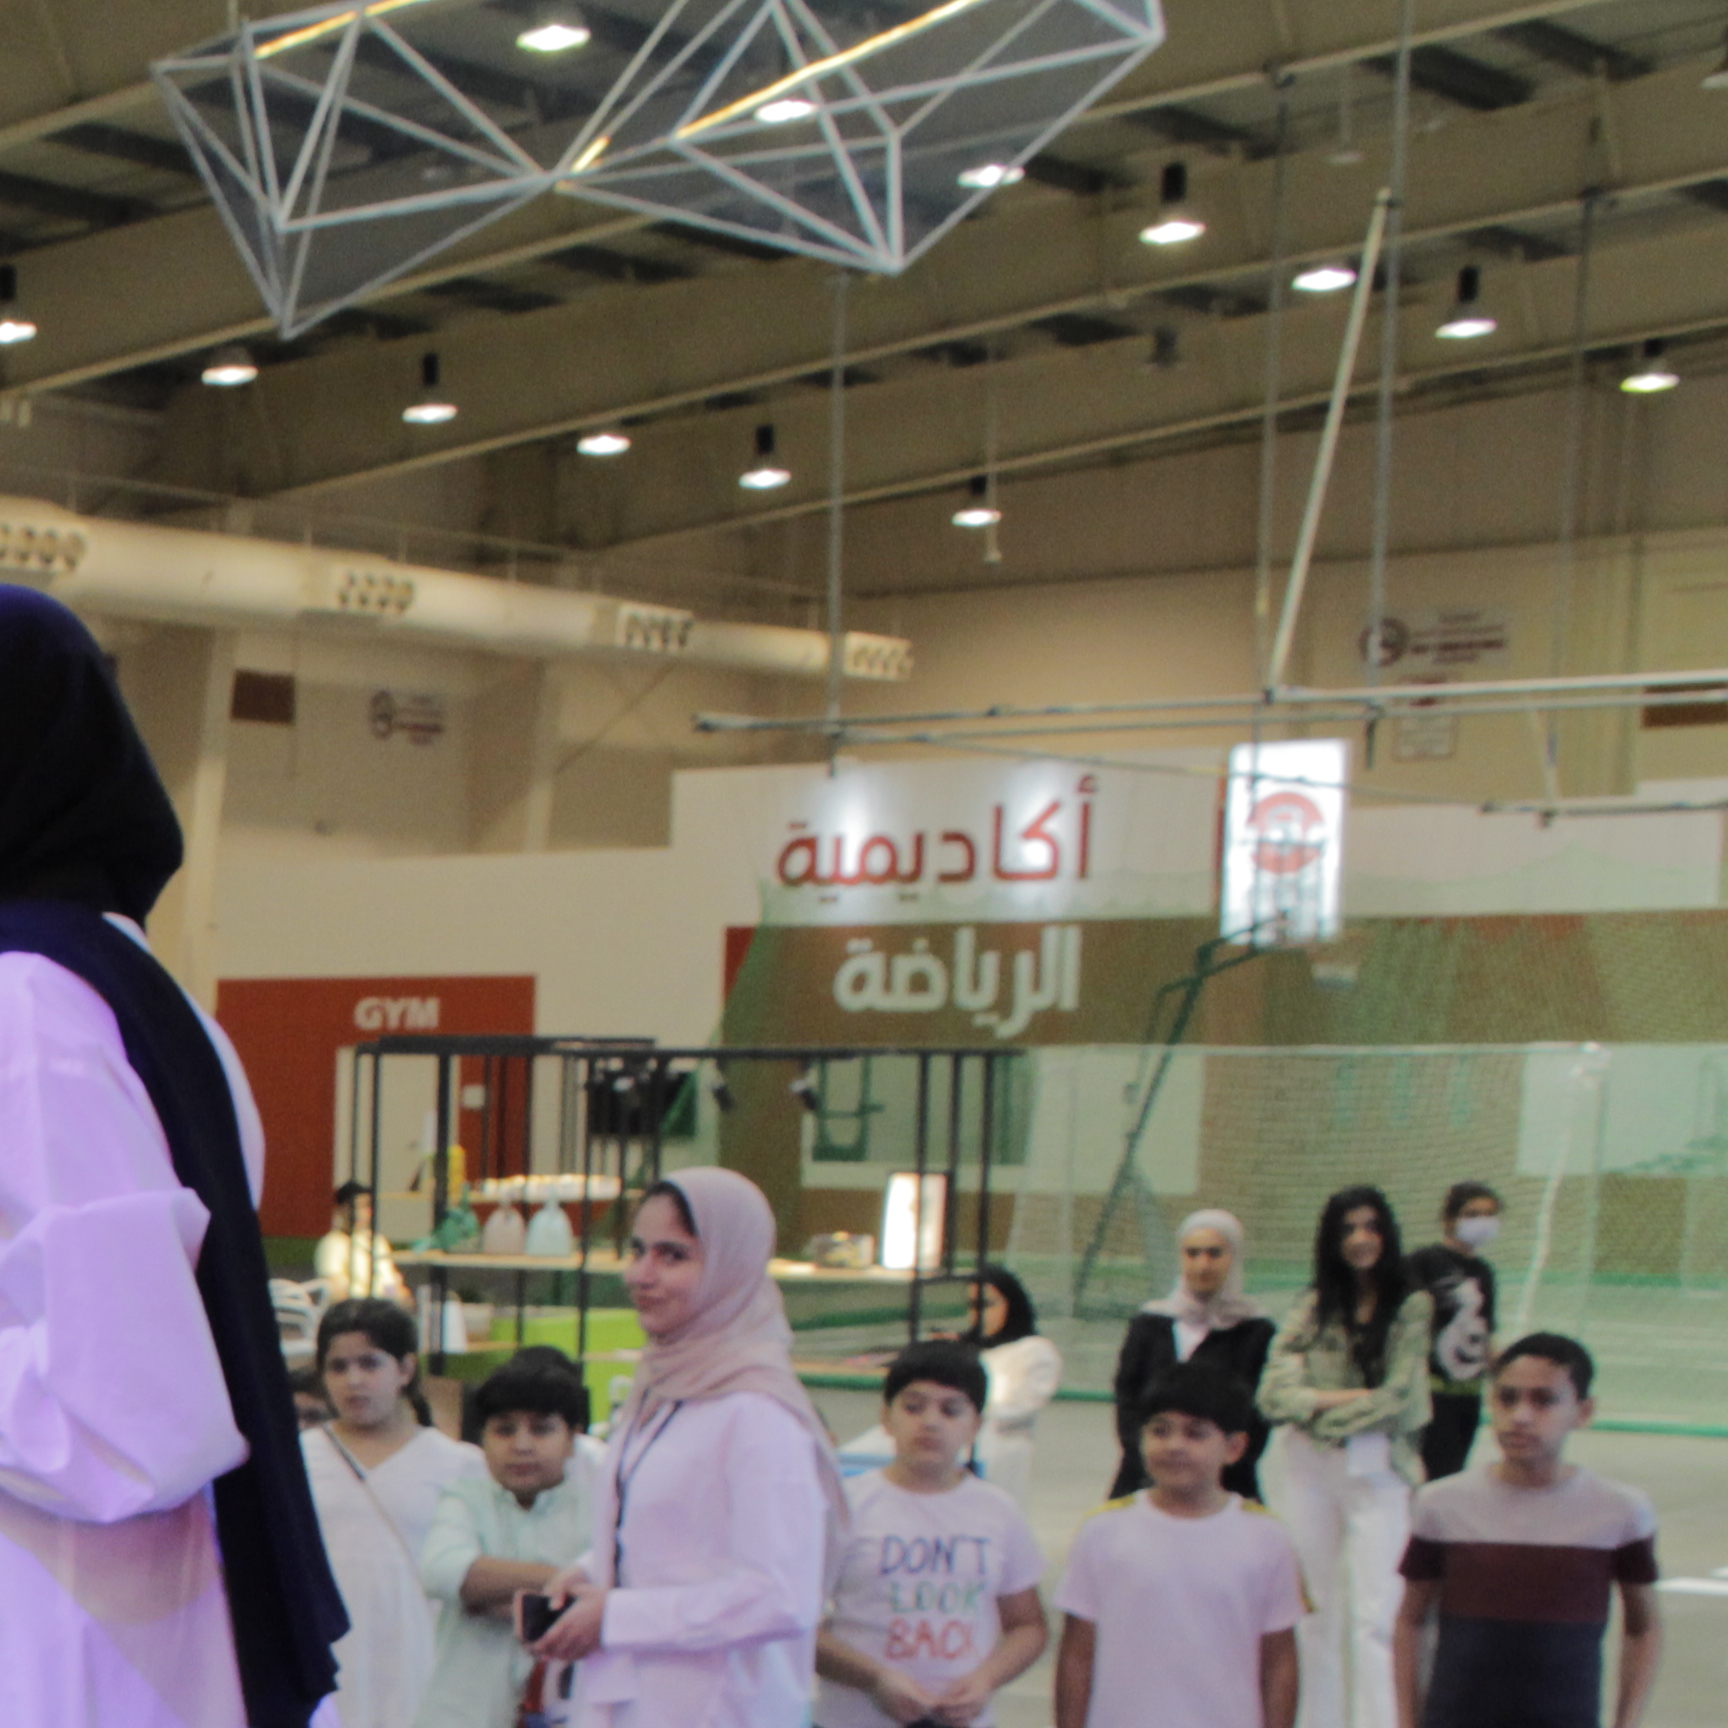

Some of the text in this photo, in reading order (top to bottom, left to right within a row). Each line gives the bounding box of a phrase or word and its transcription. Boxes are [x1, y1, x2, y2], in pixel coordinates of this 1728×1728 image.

[776, 774, 1099, 902] أكاديمية
[354, 996, 440, 1030] GYM
[833, 924, 1083, 1039] الرياضة
